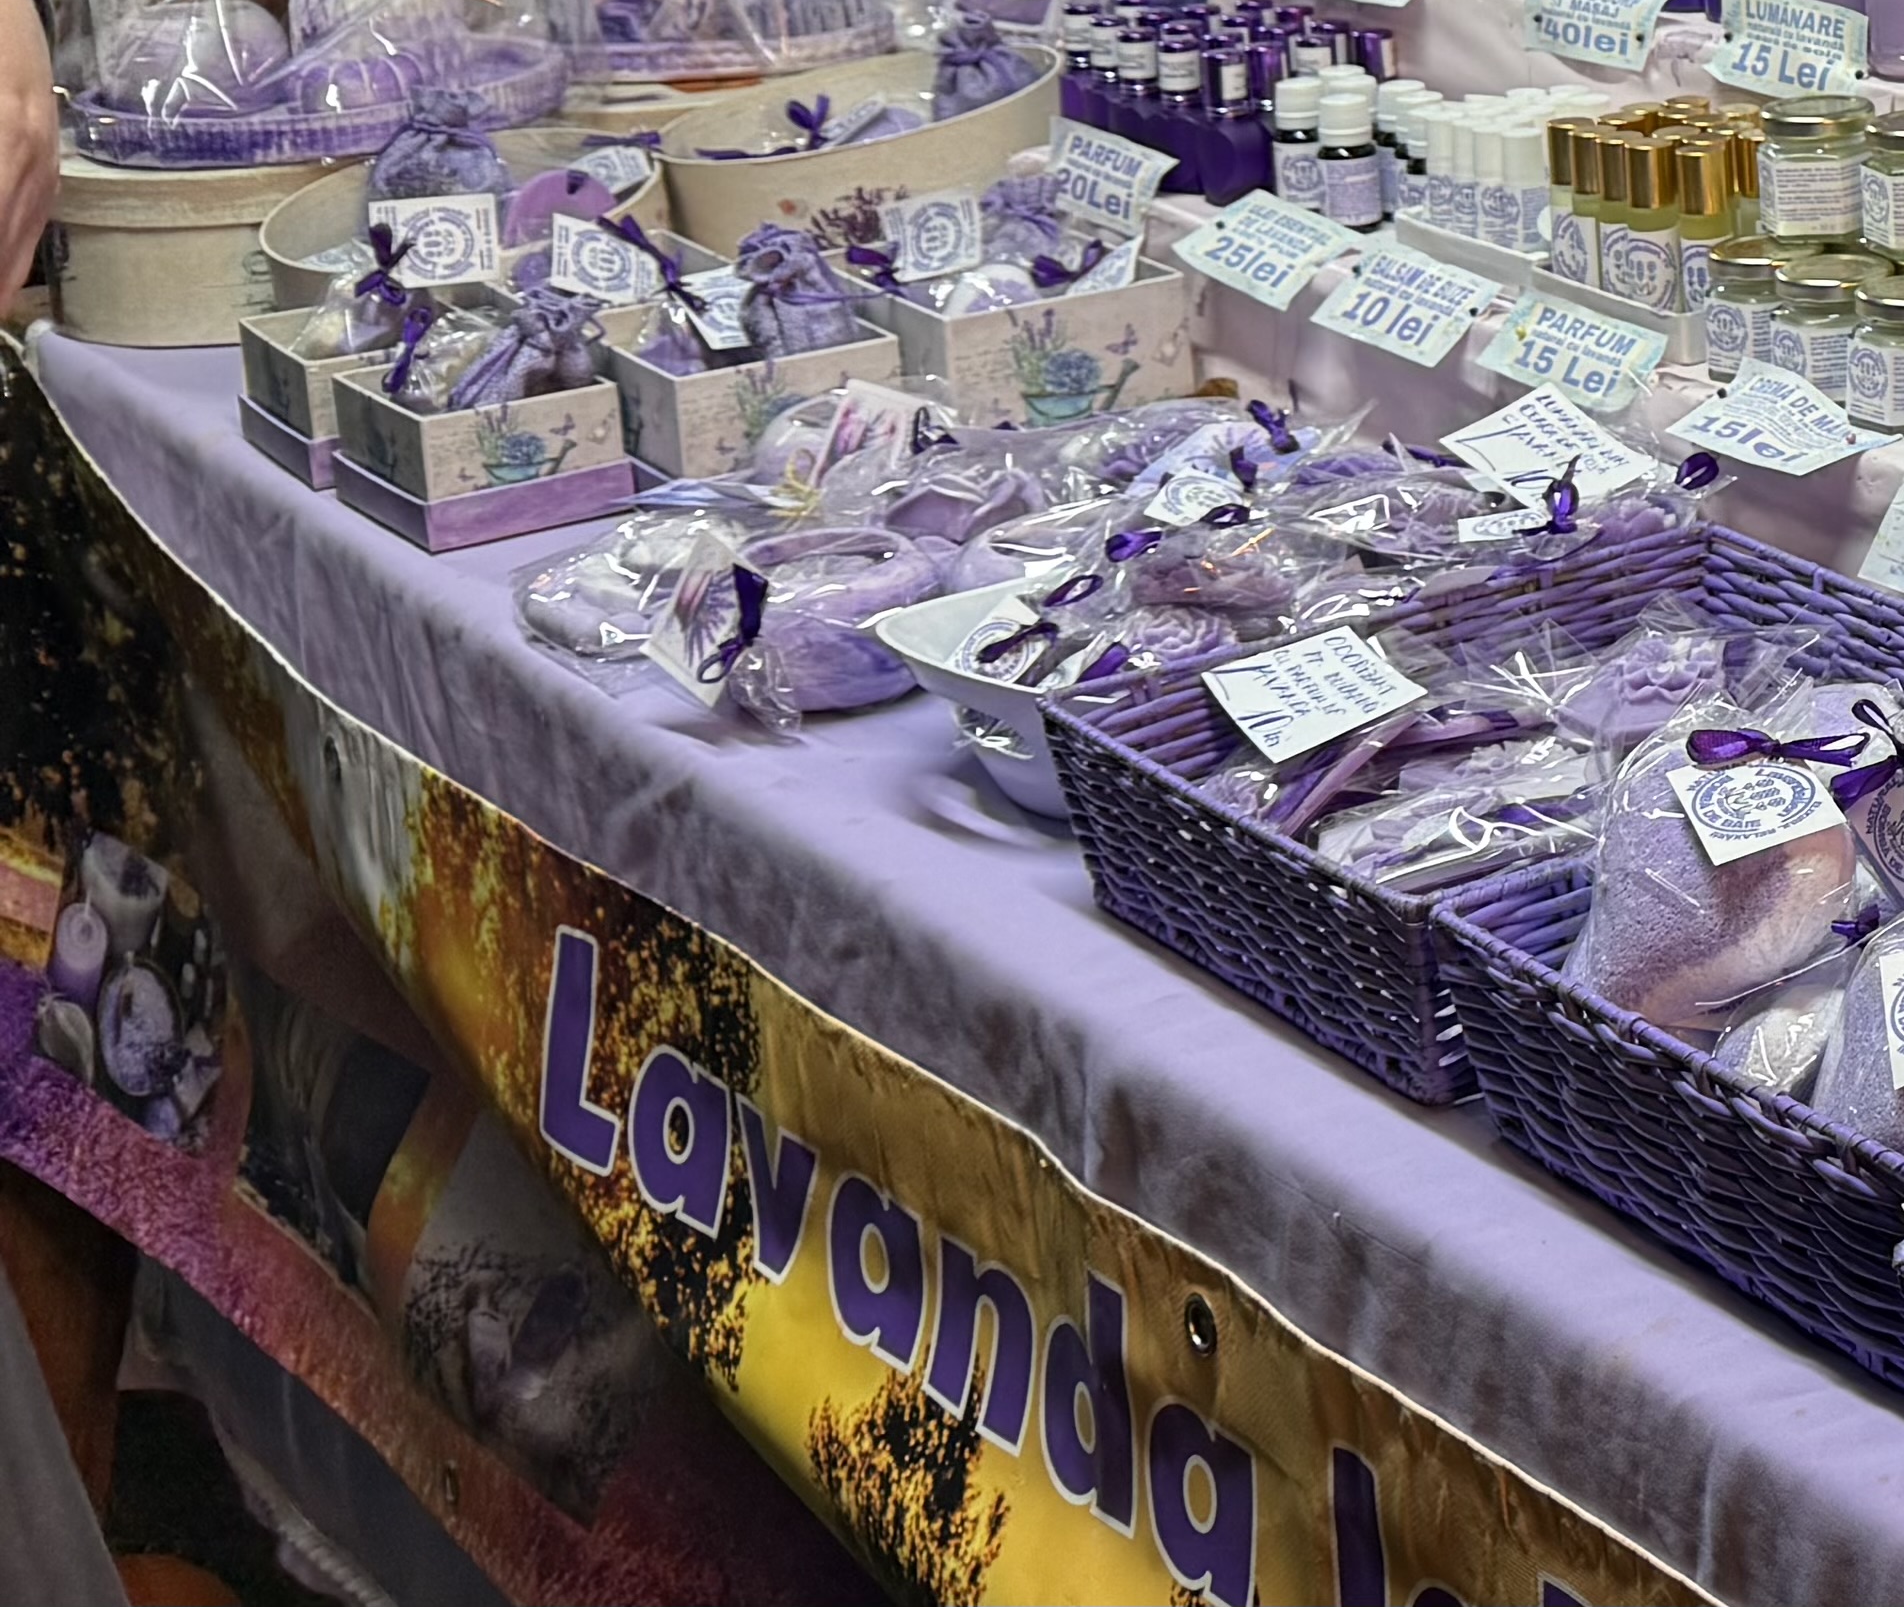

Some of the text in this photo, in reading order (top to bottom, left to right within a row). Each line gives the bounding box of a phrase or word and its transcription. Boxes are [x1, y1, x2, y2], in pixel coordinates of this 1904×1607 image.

[1569, 0, 1621, 19] MASAJ
[1543, 17, 1630, 56] 40lei
[1731, 42, 1835, 92] 15 Lei
[1069, 134, 1143, 178] PARFUM
[1056, 167, 1134, 220] 20Lei
[1205, 235, 1295, 289] 25lei
[1341, 290, 1441, 346] 10 lei
[1536, 305, 1637, 357] PARFUM
[1514, 339, 1621, 397] 15 Lei
[1790, 391, 1818, 418] DE
[1690, 414, 1809, 463] 15lei
[539, 923, 1259, 1607] Lavanda
